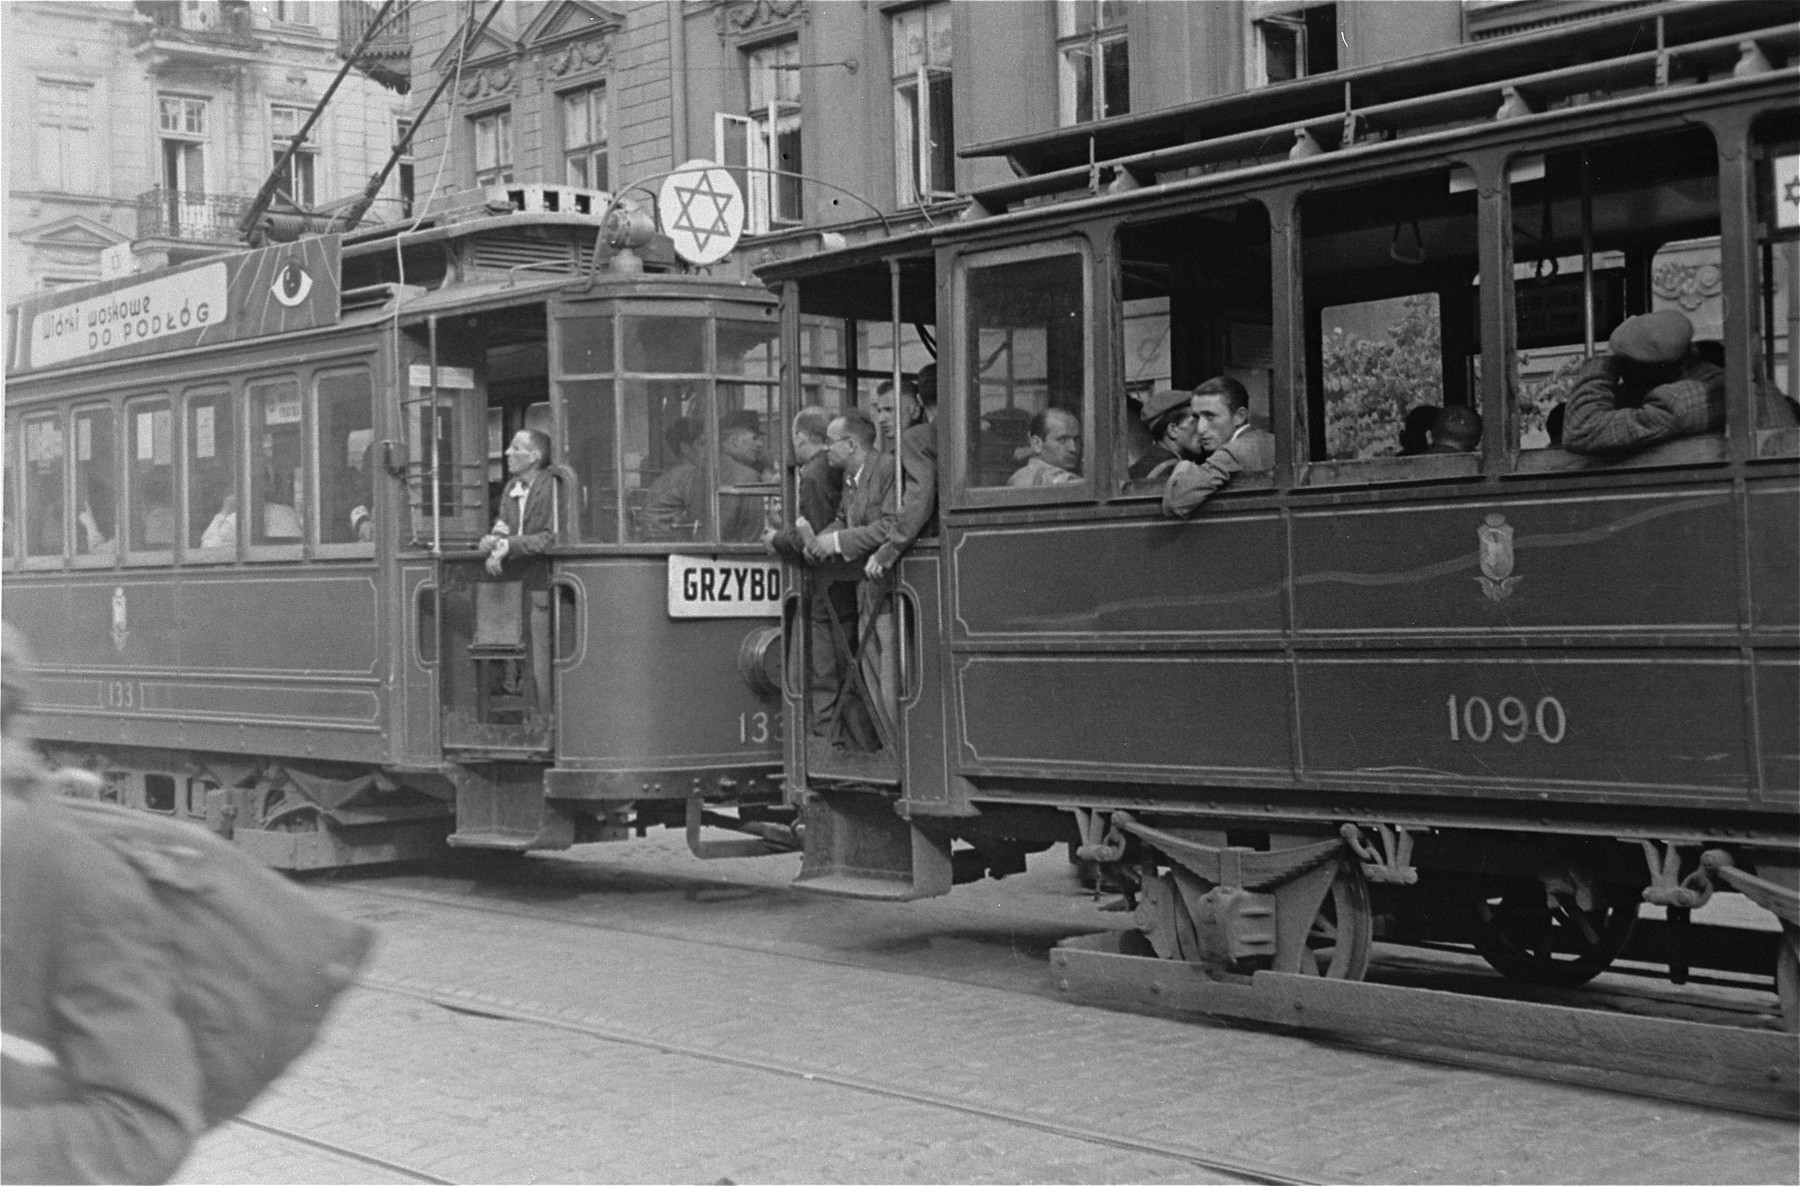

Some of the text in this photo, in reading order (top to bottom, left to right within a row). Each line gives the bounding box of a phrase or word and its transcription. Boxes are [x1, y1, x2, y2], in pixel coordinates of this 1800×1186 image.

[88, 296, 150, 328] woskowe
[89, 298, 209, 349] DO PODŁÓG
[683, 567, 780, 602] GRZYBO
[109, 681, 134, 707] 133
[1446, 694, 1566, 744] 1090
